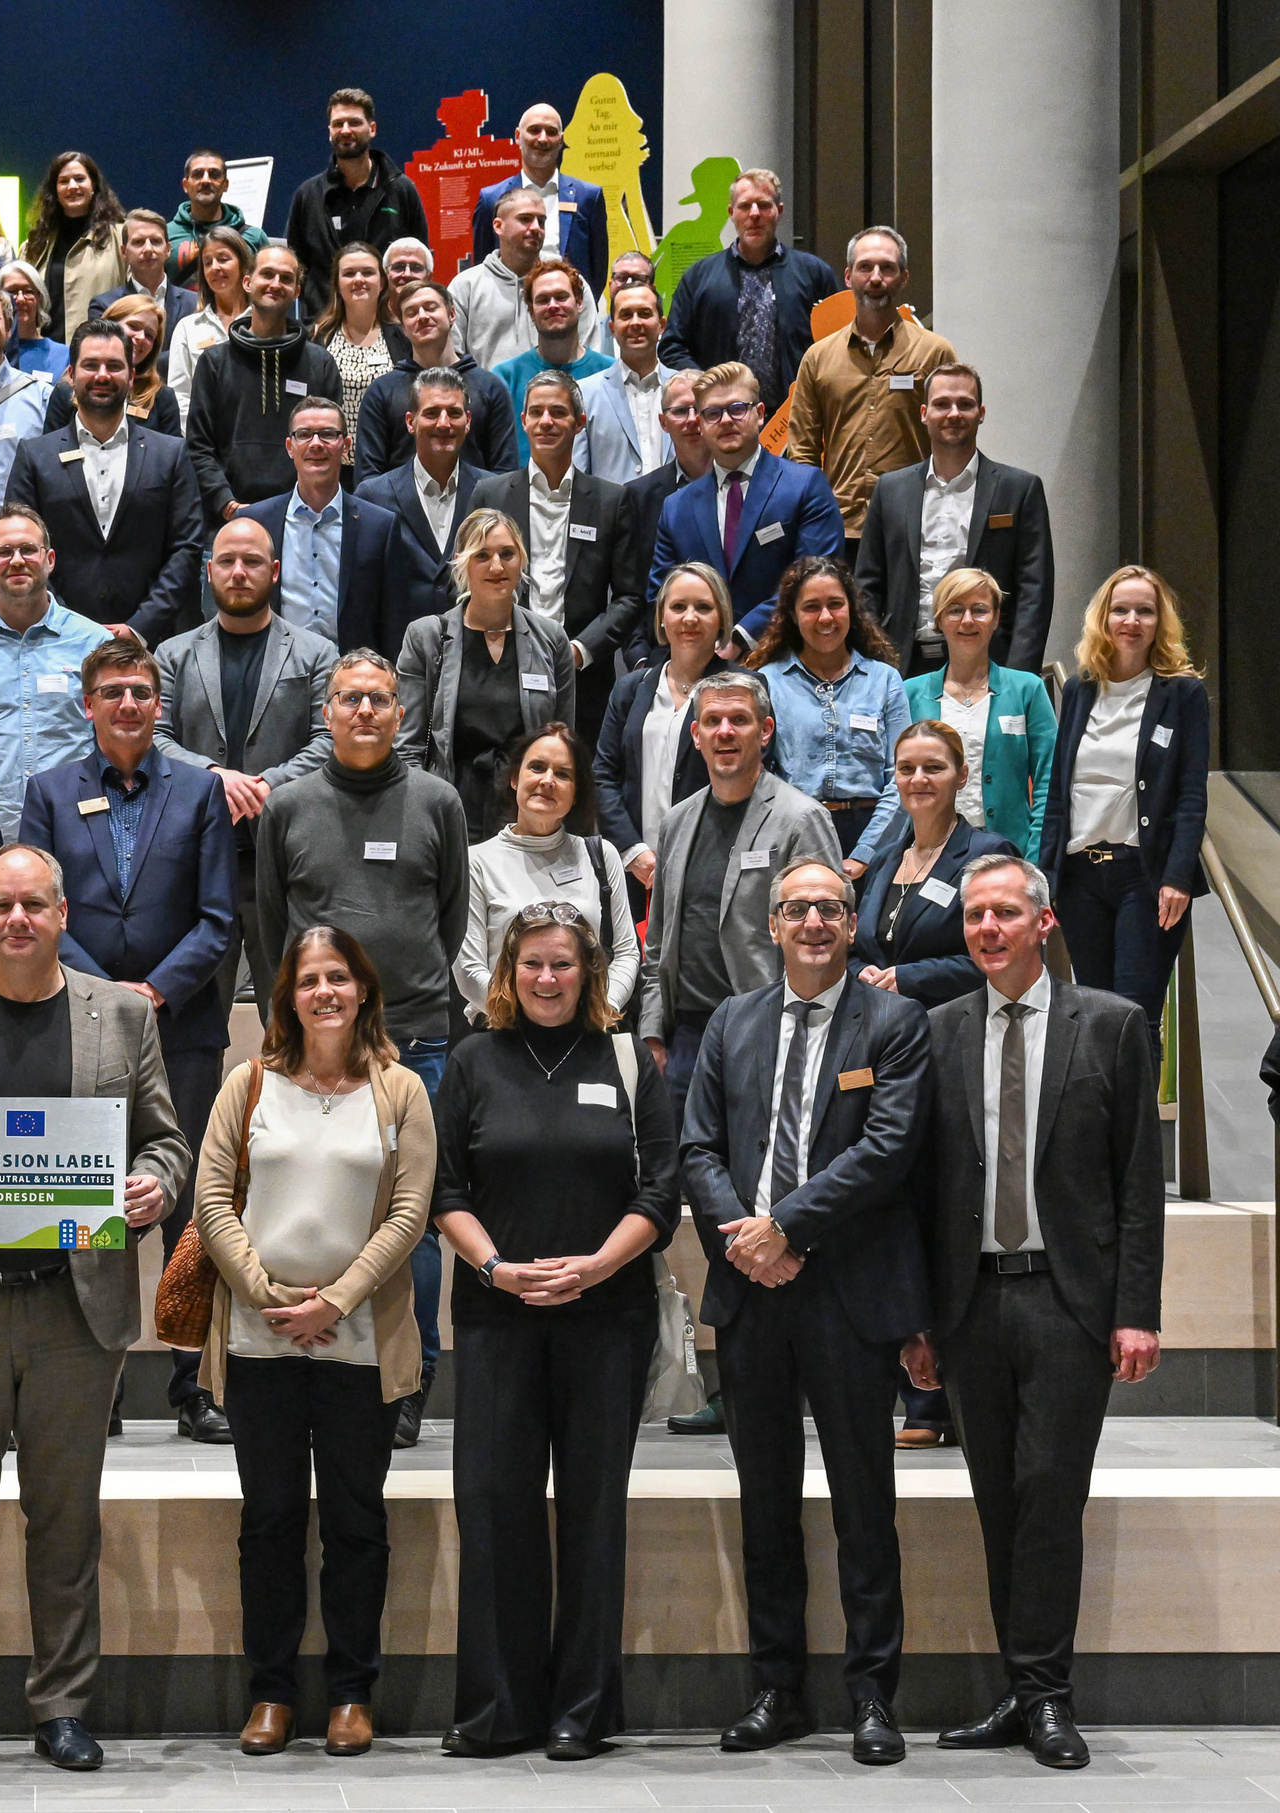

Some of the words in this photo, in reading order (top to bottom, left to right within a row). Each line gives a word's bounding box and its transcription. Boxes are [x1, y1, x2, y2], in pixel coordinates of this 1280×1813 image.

[589, 95, 617, 105] Guten
[588, 123, 600, 132] An
[603, 122, 618, 131] mir
[587, 136, 618, 145] kommt
[584, 146, 621, 159] niemand
[419, 163, 432, 172] Die
[434, 160, 464, 172] Zukunft
[465, 160, 477, 169] der
[478, 157, 520, 168] Verwaltung
[55, 1154, 115, 1169] LABEL
[33, 1174, 41, 1183] &
[43, 1174, 77, 1184] SMART
[80, 1175, 112, 1184] CITIES
